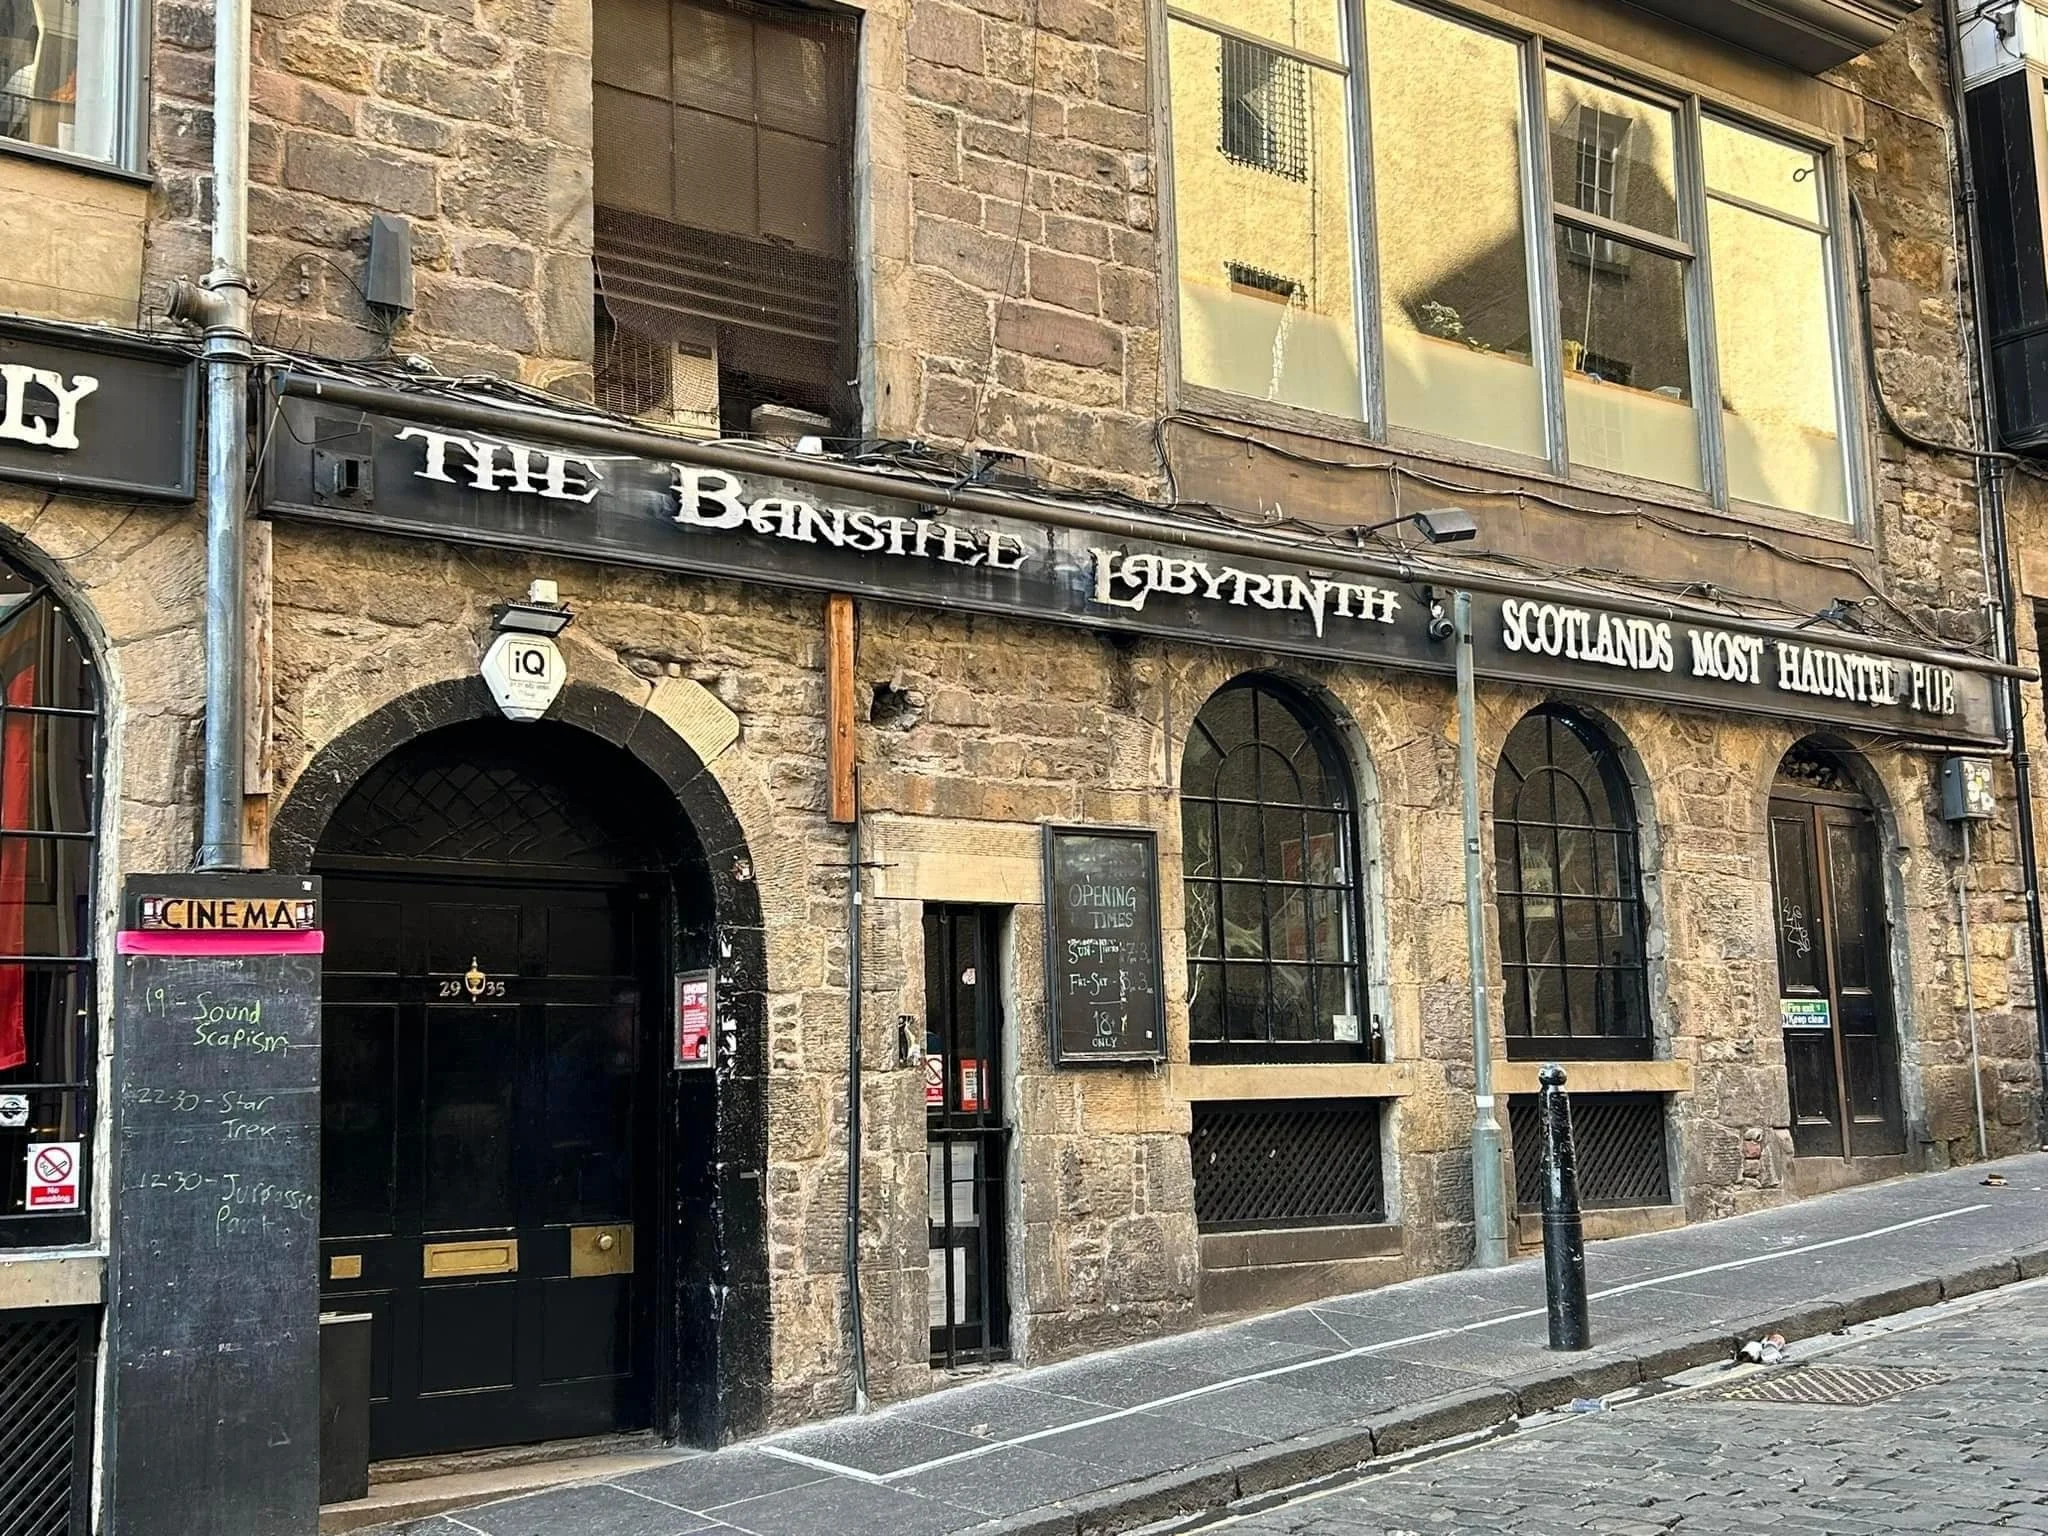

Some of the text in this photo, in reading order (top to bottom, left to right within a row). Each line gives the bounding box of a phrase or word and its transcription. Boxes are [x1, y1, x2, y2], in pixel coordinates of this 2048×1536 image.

[394, 426, 603, 504] THE
[514, 649, 545, 677] iQ
[1501, 598, 1674, 673] SCOTLANDS
[1688, 629, 1764, 685] MOST
[1909, 662, 1955, 715] PUB
[1068, 883, 1137, 912] OPENING
[161, 899, 297, 929] CINEMA
[1088, 911, 1134, 929] TIMES
[440, 980, 461, 997] 29
[486, 981, 505, 997] 35
[146, 987, 165, 1018] 19
[192, 991, 261, 1025] Sound
[1091, 1037, 1117, 1048] ONLY
[219, 1091, 275, 1114] Star
